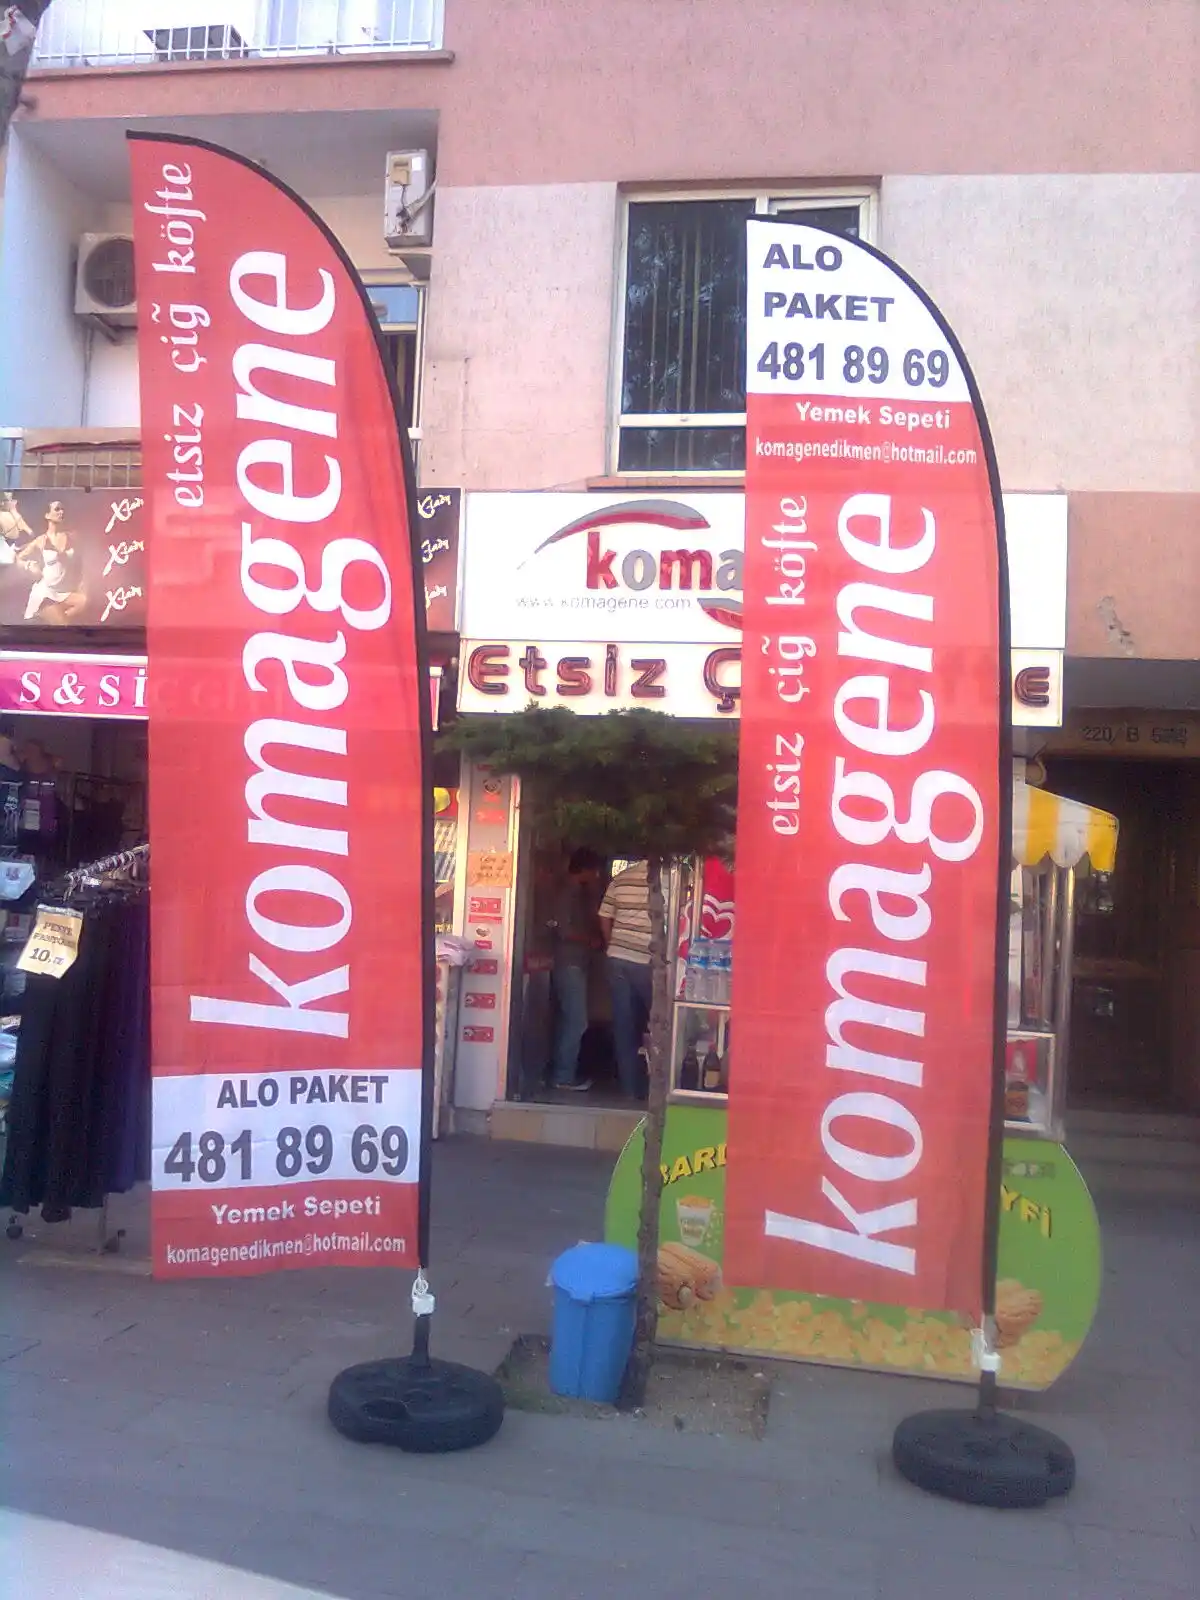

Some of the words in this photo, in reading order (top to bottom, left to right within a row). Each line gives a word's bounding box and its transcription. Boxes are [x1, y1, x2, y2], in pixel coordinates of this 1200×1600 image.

[144, 162, 207, 274] köfte
[763, 243, 843, 272] ALO
[151, 303, 211, 373] çiğ
[764, 291, 895, 323] PAKET
[757, 341, 825, 381] 481
[843, 344, 889, 384] 89
[903, 348, 949, 388] 69
[795, 401, 871, 425] Yemek
[879, 405, 951, 431] Sepeti
[163, 402, 205, 508] etsiz
[761, 495, 818, 606] köfte
[189, 250, 392, 1039] komagene
[761, 635, 817, 703] çiğ
[766, 732, 805, 836] etsiz
[765, 493, 983, 1275] komagene
[216, 1079, 279, 1109] ALO
[290, 1075, 389, 1105] PAKET
[163, 1129, 252, 1183] 481
[275, 1124, 333, 1178] 89
[351, 1123, 409, 1177] 69
[211, 1201, 295, 1225] Yemek
[303, 1195, 381, 1219] Sepeti
